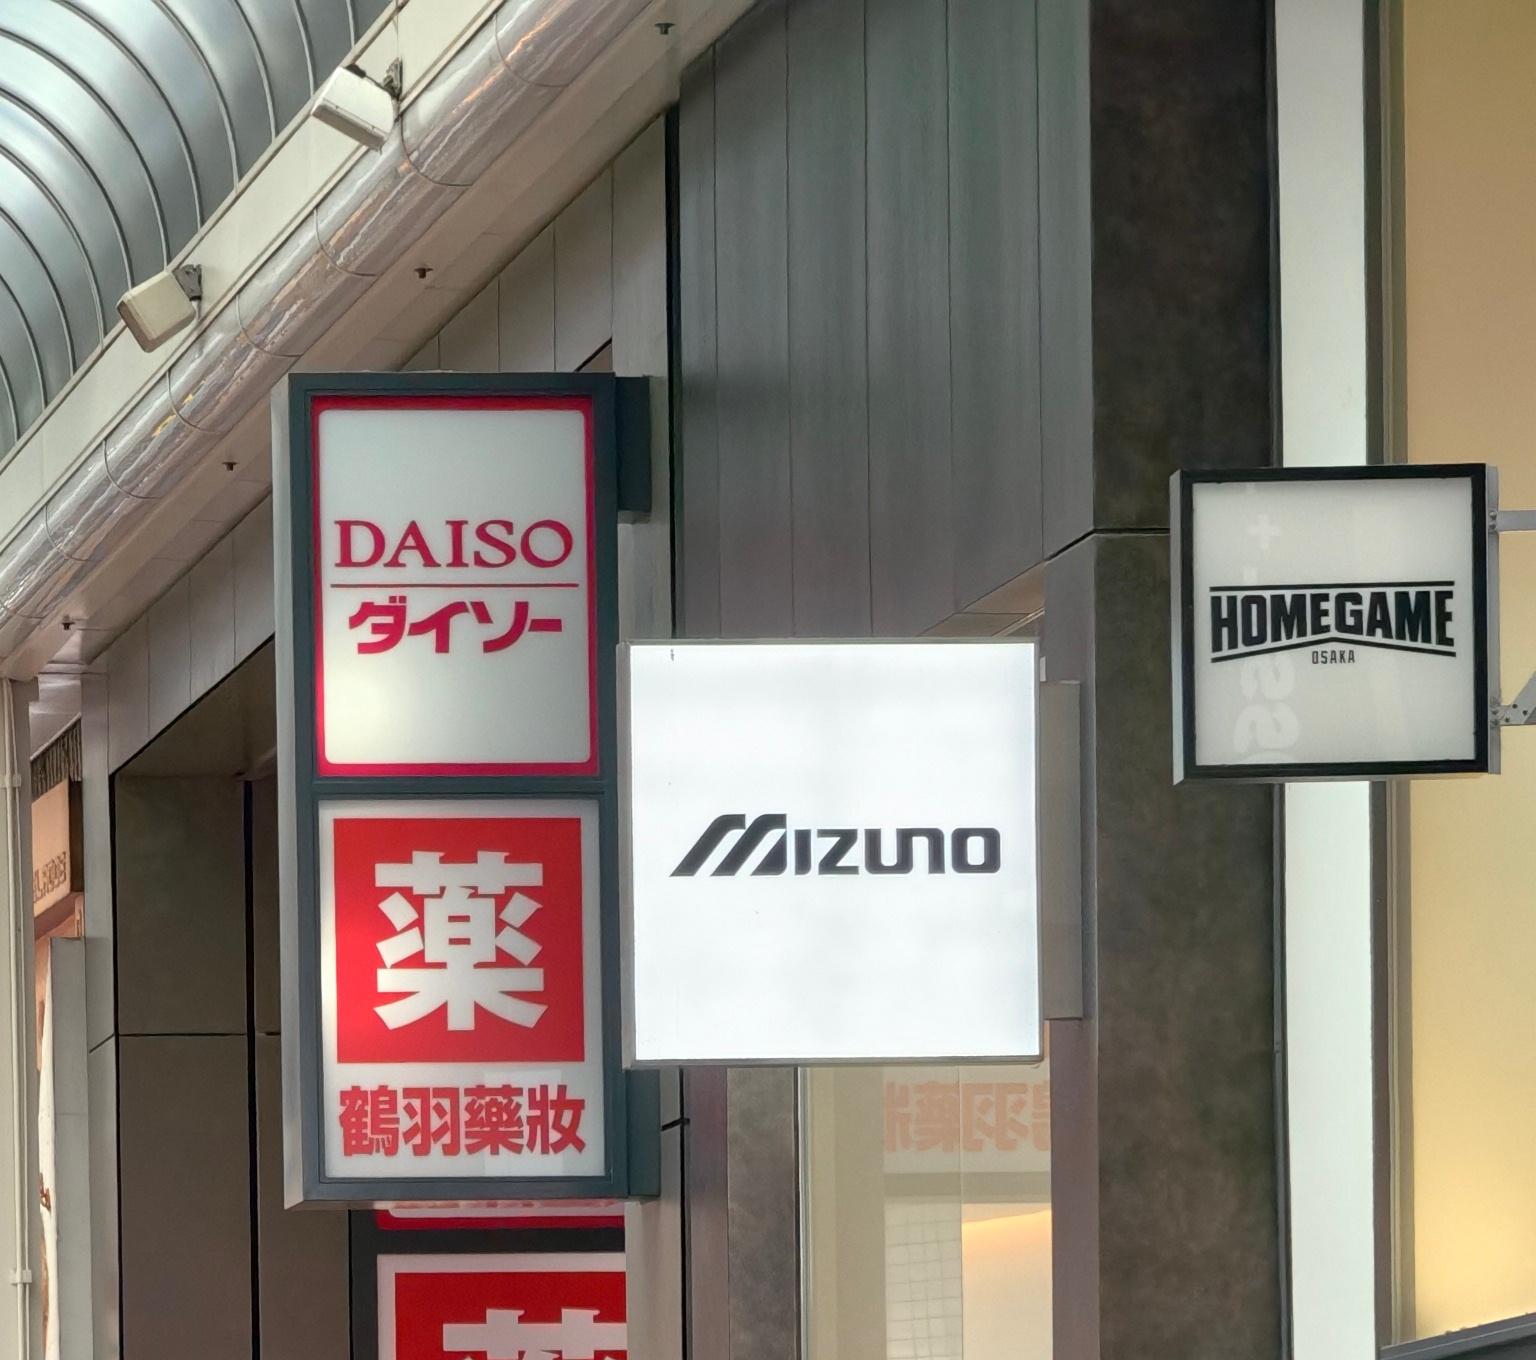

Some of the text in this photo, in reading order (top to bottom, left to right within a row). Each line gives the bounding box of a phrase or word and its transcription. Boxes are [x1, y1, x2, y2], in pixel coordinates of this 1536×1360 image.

[335, 519, 573, 568] DAISO
[348, 596, 562, 655] ダイソー
[1210, 591, 1454, 652] HOMEGAME
[1312, 651, 1355, 665] OSAKA
[669, 814, 1001, 876] MIZUNO
[374, 851, 550, 1031] 薬
[339, 1085, 586, 1157] 鶴羽藥妝
